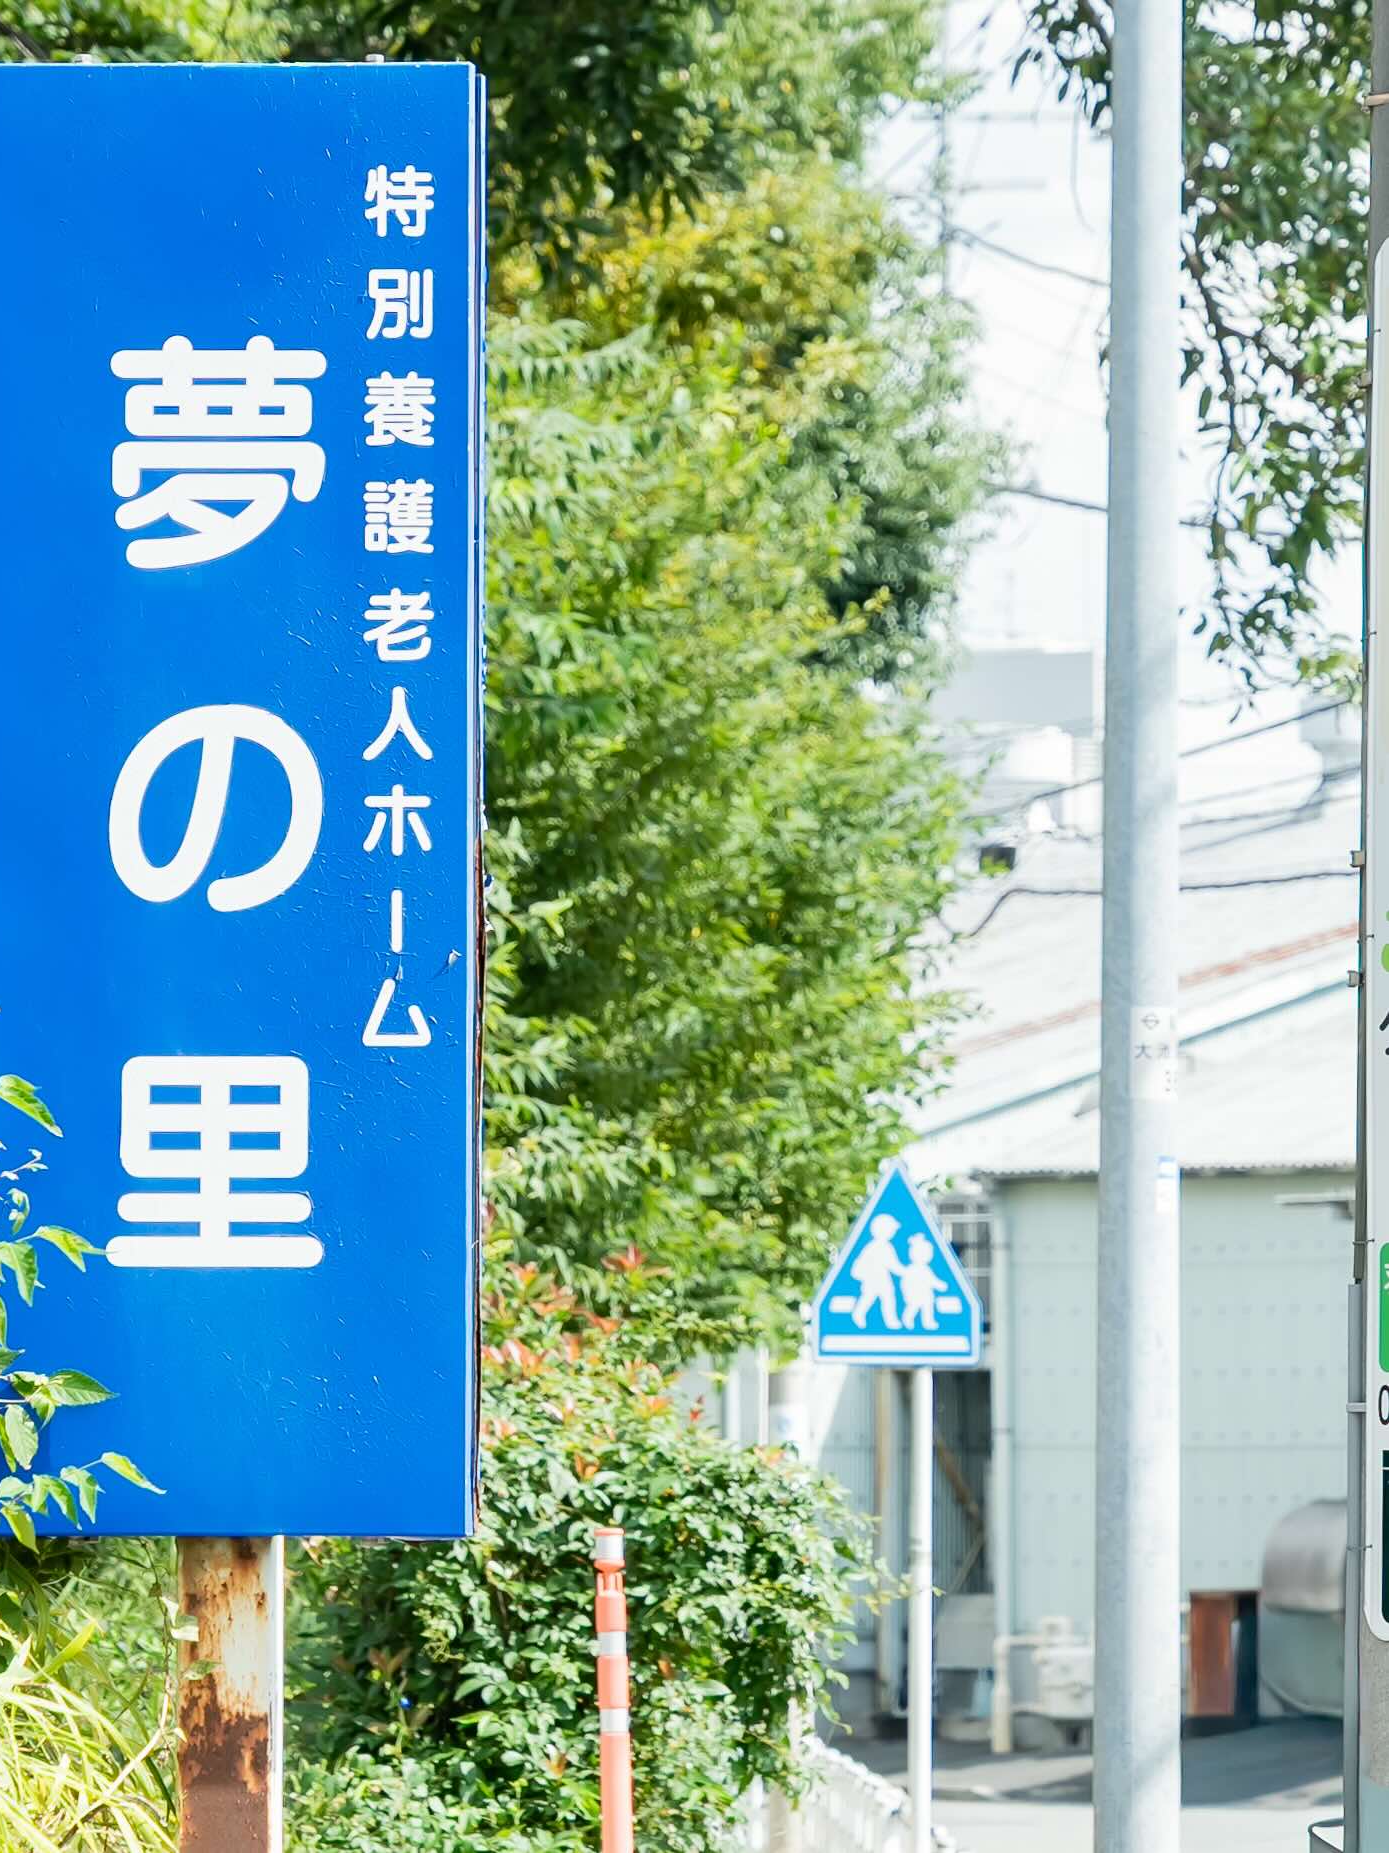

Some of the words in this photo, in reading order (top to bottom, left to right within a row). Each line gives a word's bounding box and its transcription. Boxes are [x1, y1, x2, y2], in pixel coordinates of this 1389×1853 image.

[106, 335, 328, 1269] 夢の里
[363, 164, 436, 1047] 特別養護老人ホーム
